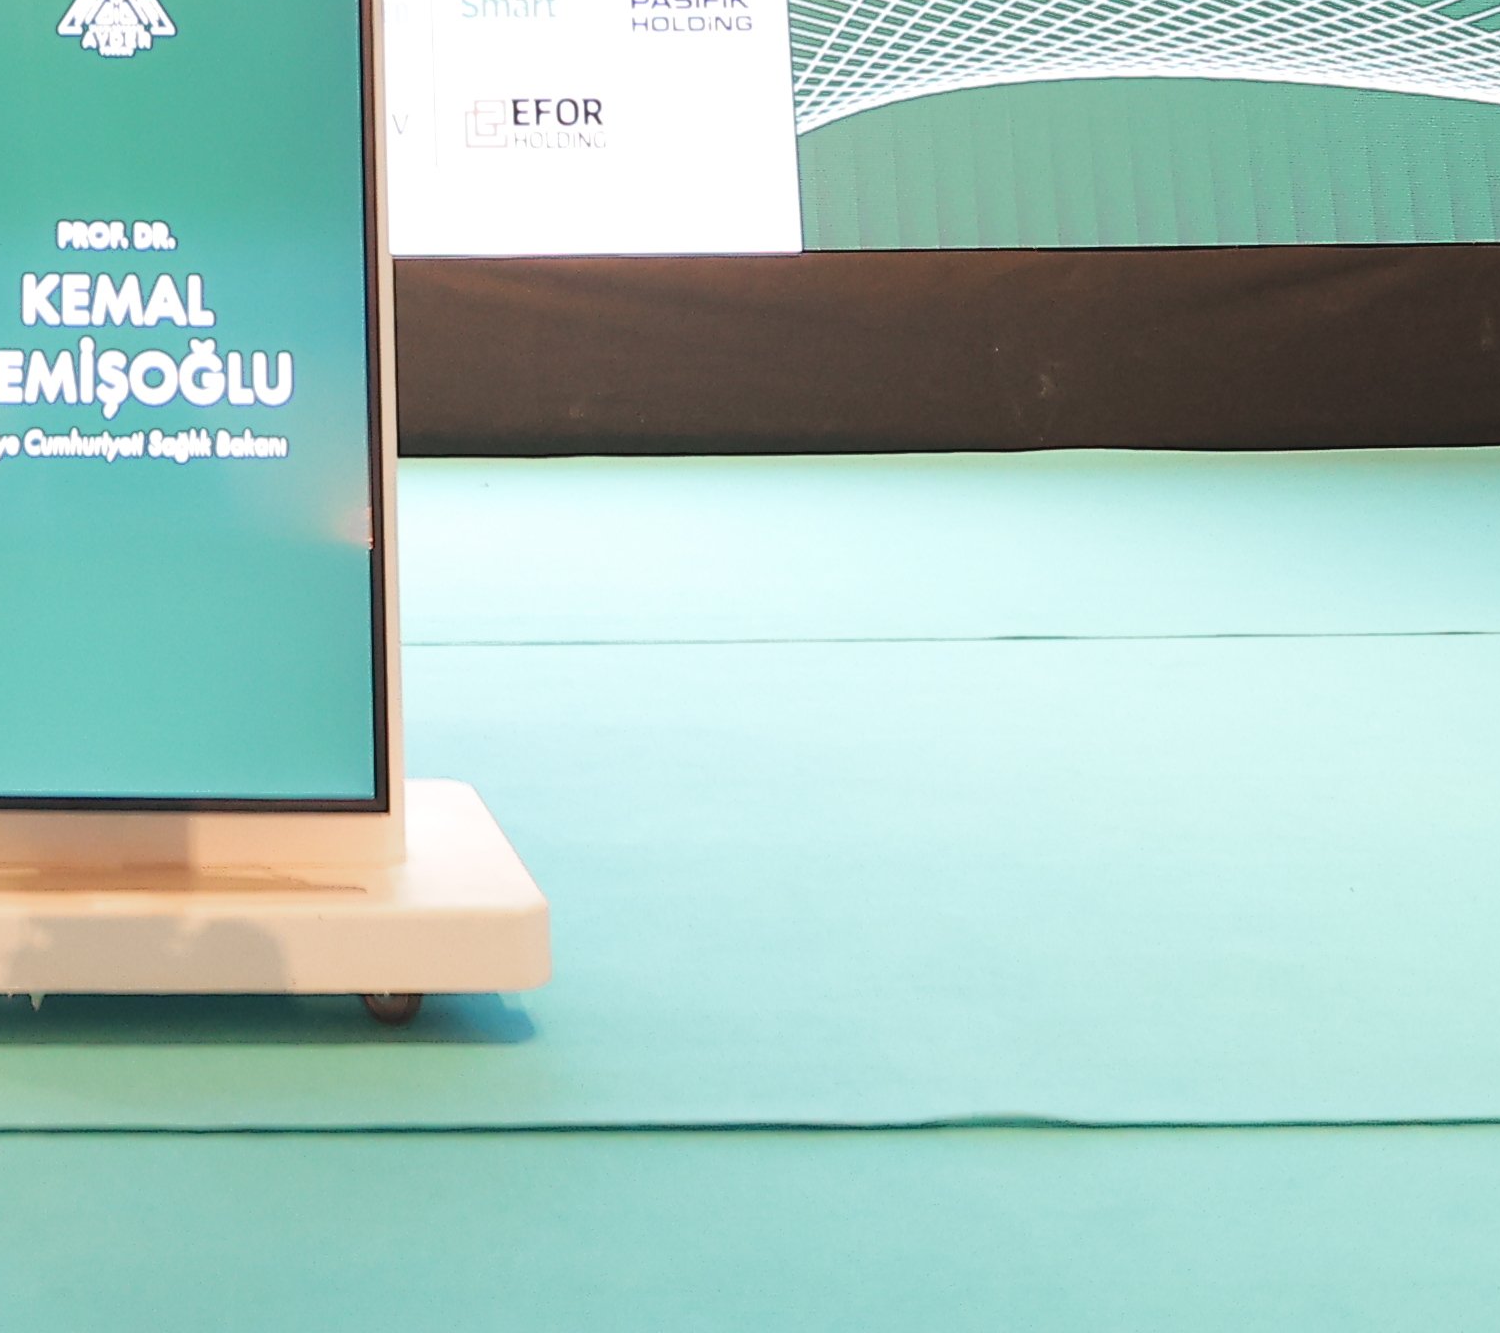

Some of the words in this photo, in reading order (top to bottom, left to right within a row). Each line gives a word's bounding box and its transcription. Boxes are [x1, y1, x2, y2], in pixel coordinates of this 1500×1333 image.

[511, 98, 603, 126] EFOR
[514, 131, 607, 148] HOLDING
[57, 220, 130, 250] PROF.
[133, 221, 177, 250] DR.
[22, 273, 215, 327] KEMAL
[23, 428, 145, 462] Cumhuriyeti
[147, 429, 212, 463] Sağlık
